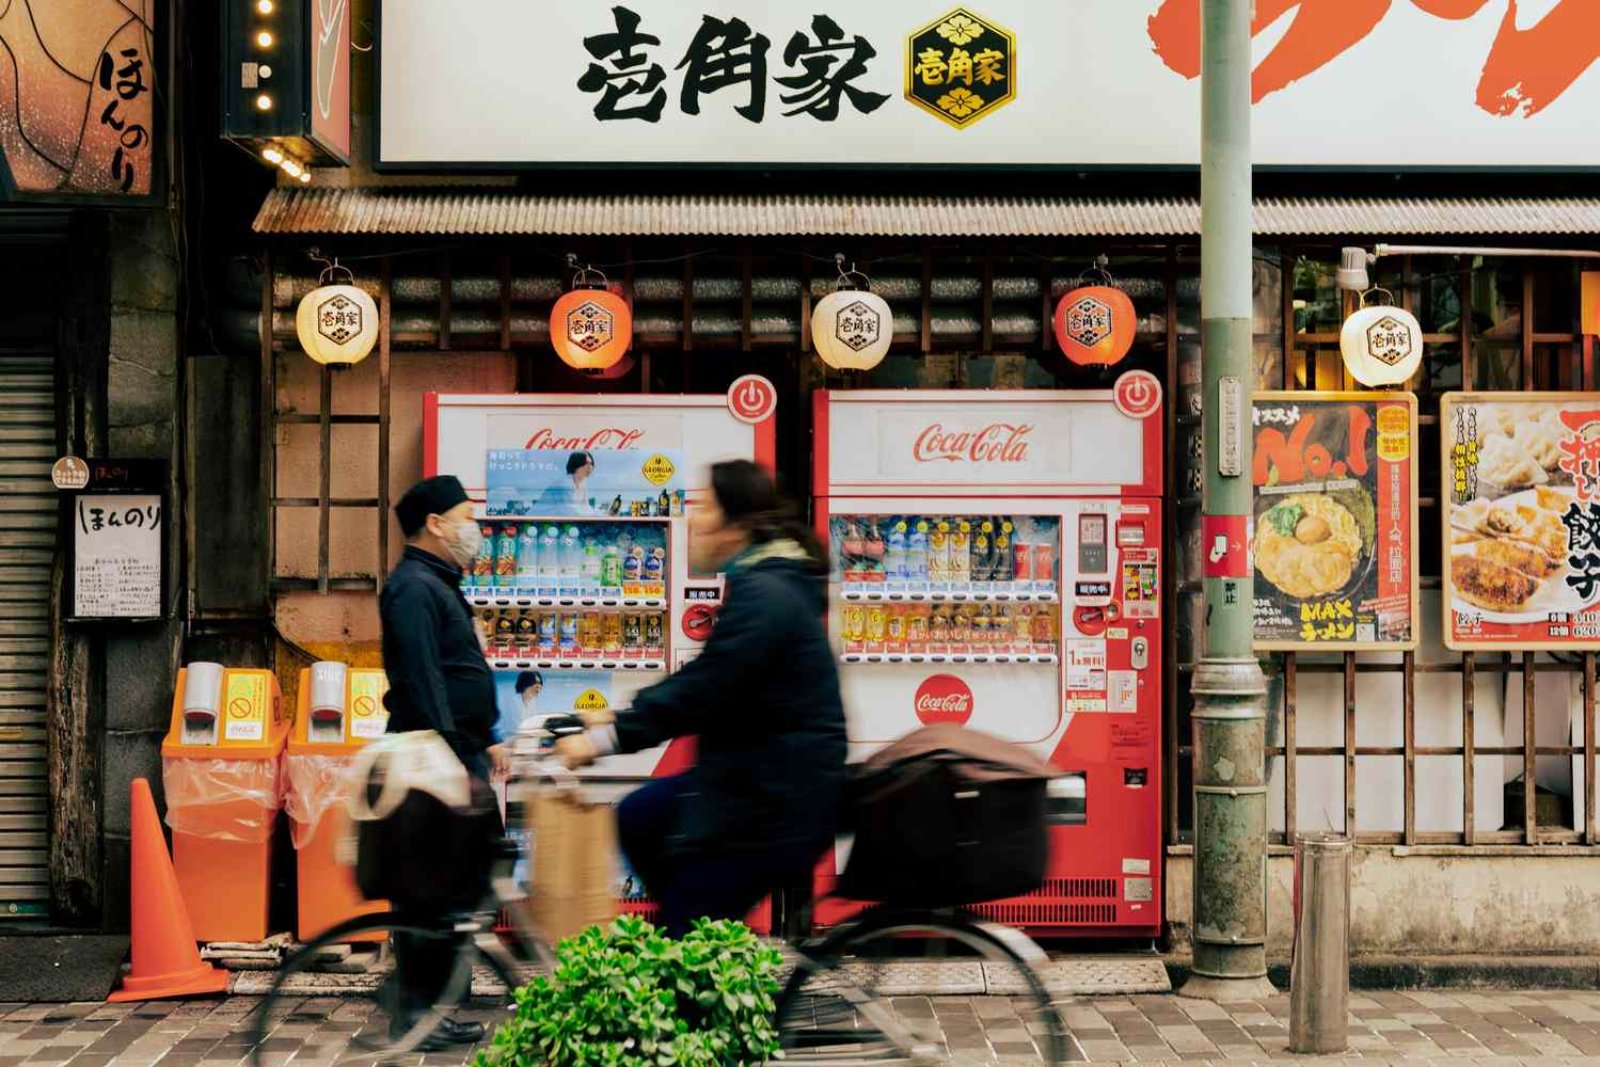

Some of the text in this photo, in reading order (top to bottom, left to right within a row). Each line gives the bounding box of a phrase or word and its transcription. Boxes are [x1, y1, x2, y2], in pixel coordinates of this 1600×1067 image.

[577, 5, 892, 123] 壱角家
[914, 46, 1006, 86] 壱角家
[101, 48, 148, 192] ほんのり
[321, 311, 359, 327] 壱角家
[571, 319, 608, 335] 壱角家
[840, 317, 876, 335] 壱角家
[1069, 312, 1106, 328] 壱角家
[1372, 332, 1408, 349] 壱角家
[913, 423, 1033, 462] Coca-Cola
[644, 464, 673, 473] GEORGIA
[79, 501, 160, 534] ほんのり
[1301, 600, 1354, 621] MAX
[917, 693, 970, 712] Coca-Cola
